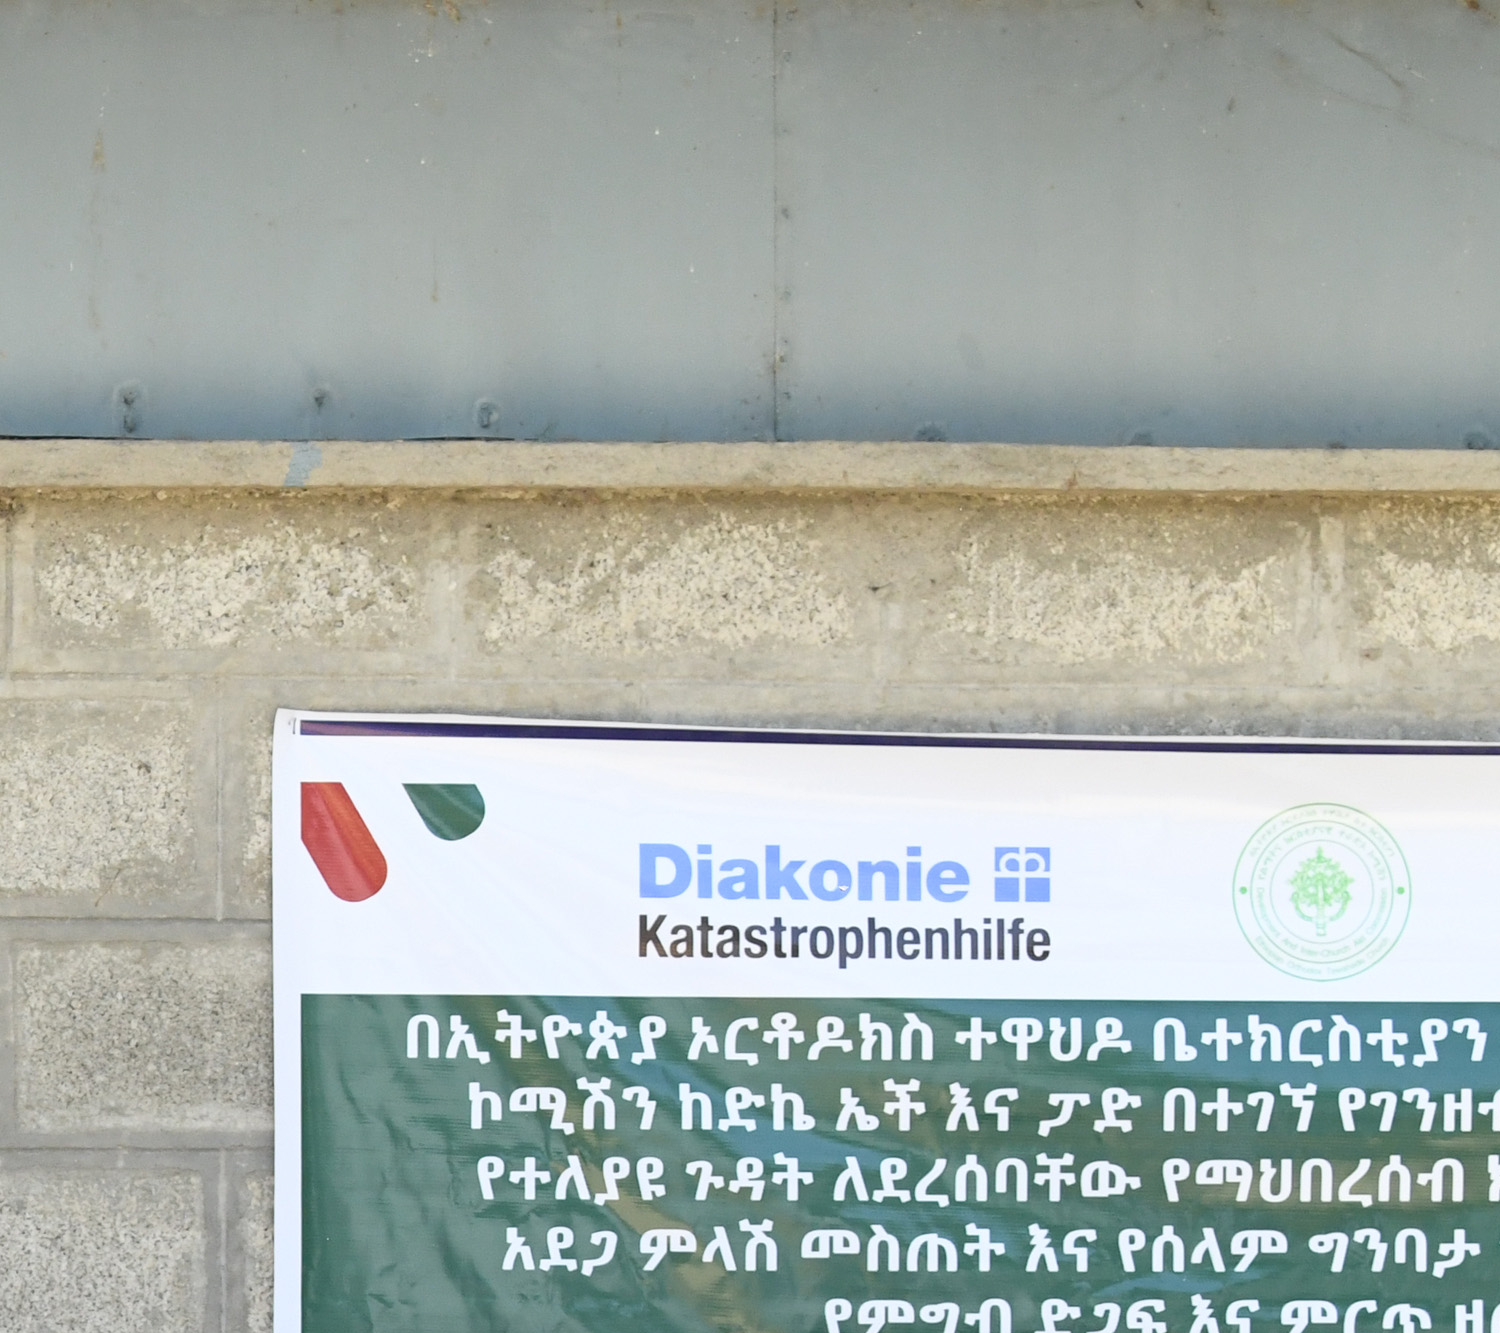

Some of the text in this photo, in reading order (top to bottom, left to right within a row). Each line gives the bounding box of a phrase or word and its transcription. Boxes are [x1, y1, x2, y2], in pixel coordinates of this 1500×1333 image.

[639, 843, 971, 903] Diakonie
[638, 914, 1052, 970] Katastrophenhilfe
[406, 1009, 667, 1065] በኢትዮጵያ
[687, 1012, 934, 1066] ኦርቶዶክስ
[954, 1016, 1133, 1062] ተዋህዶ
[1153, 1014, 1488, 1067] ቤተክርስቲያን
[468, 1077, 657, 1135] ኮሚሽን
[835, 1078, 927, 1131] ኤች
[945, 1082, 1020, 1131] እና
[1037, 1086, 1143, 1137] ፓድ
[1162, 1082, 1318, 1132] በተገኘ
[476, 1155, 667, 1206] የተለያዩ
[685, 1152, 815, 1202] ጉዳት
[833, 1153, 1142, 1207] ለደረሰባቸው
[1162, 1155, 1465, 1207] የማህበረሰብ
[501, 1226, 619, 1276] አደጋ
[639, 1219, 778, 1272] ምላሽ
[800, 1223, 1006, 1272] መስጠት
[1025, 1223, 1098, 1272] እና
[1118, 1225, 1289, 1272] የሰላም
[1308, 1228, 1482, 1278] ግንባታ
